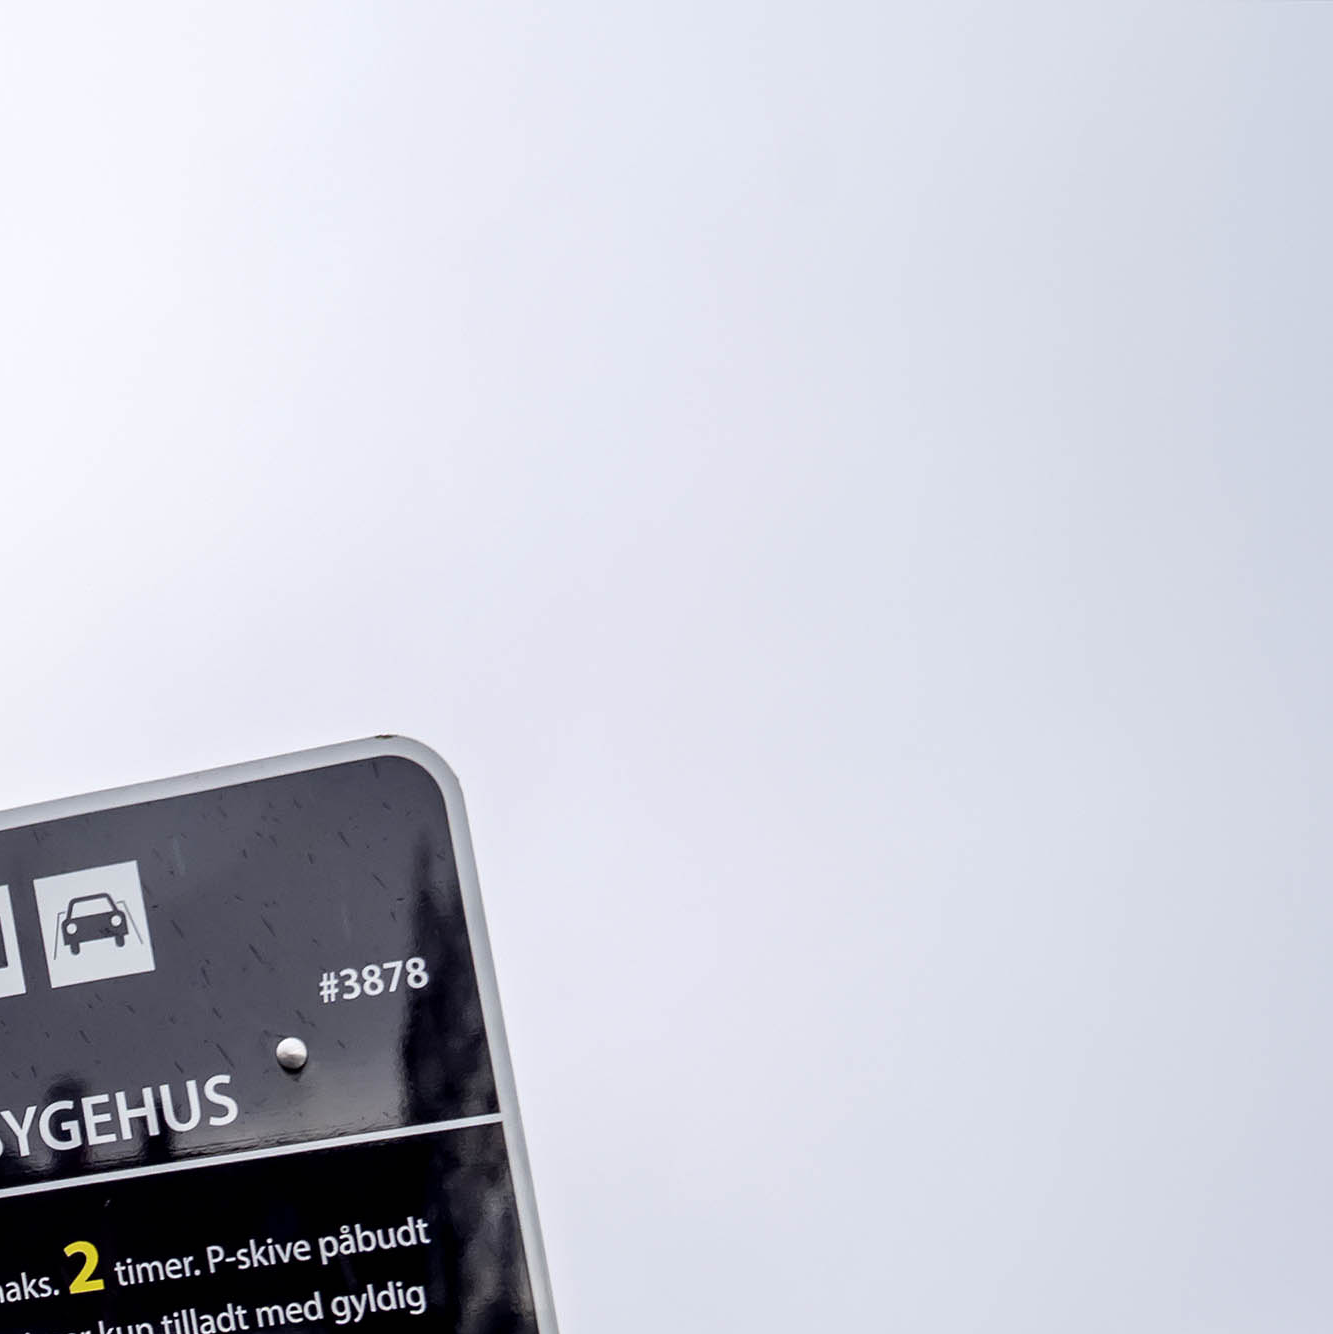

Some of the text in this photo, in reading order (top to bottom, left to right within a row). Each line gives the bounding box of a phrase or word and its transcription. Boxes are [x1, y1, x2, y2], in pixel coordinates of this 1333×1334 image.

[319, 957, 430, 1004] #3878
[63, 1240, 105, 1292] 2
[114, 1255, 201, 1287] timer.
[206, 1238, 312, 1274] P-skive
[318, 1216, 432, 1266] påbudt
[255, 1291, 324, 1328] med
[331, 1281, 427, 1325] gyldig
